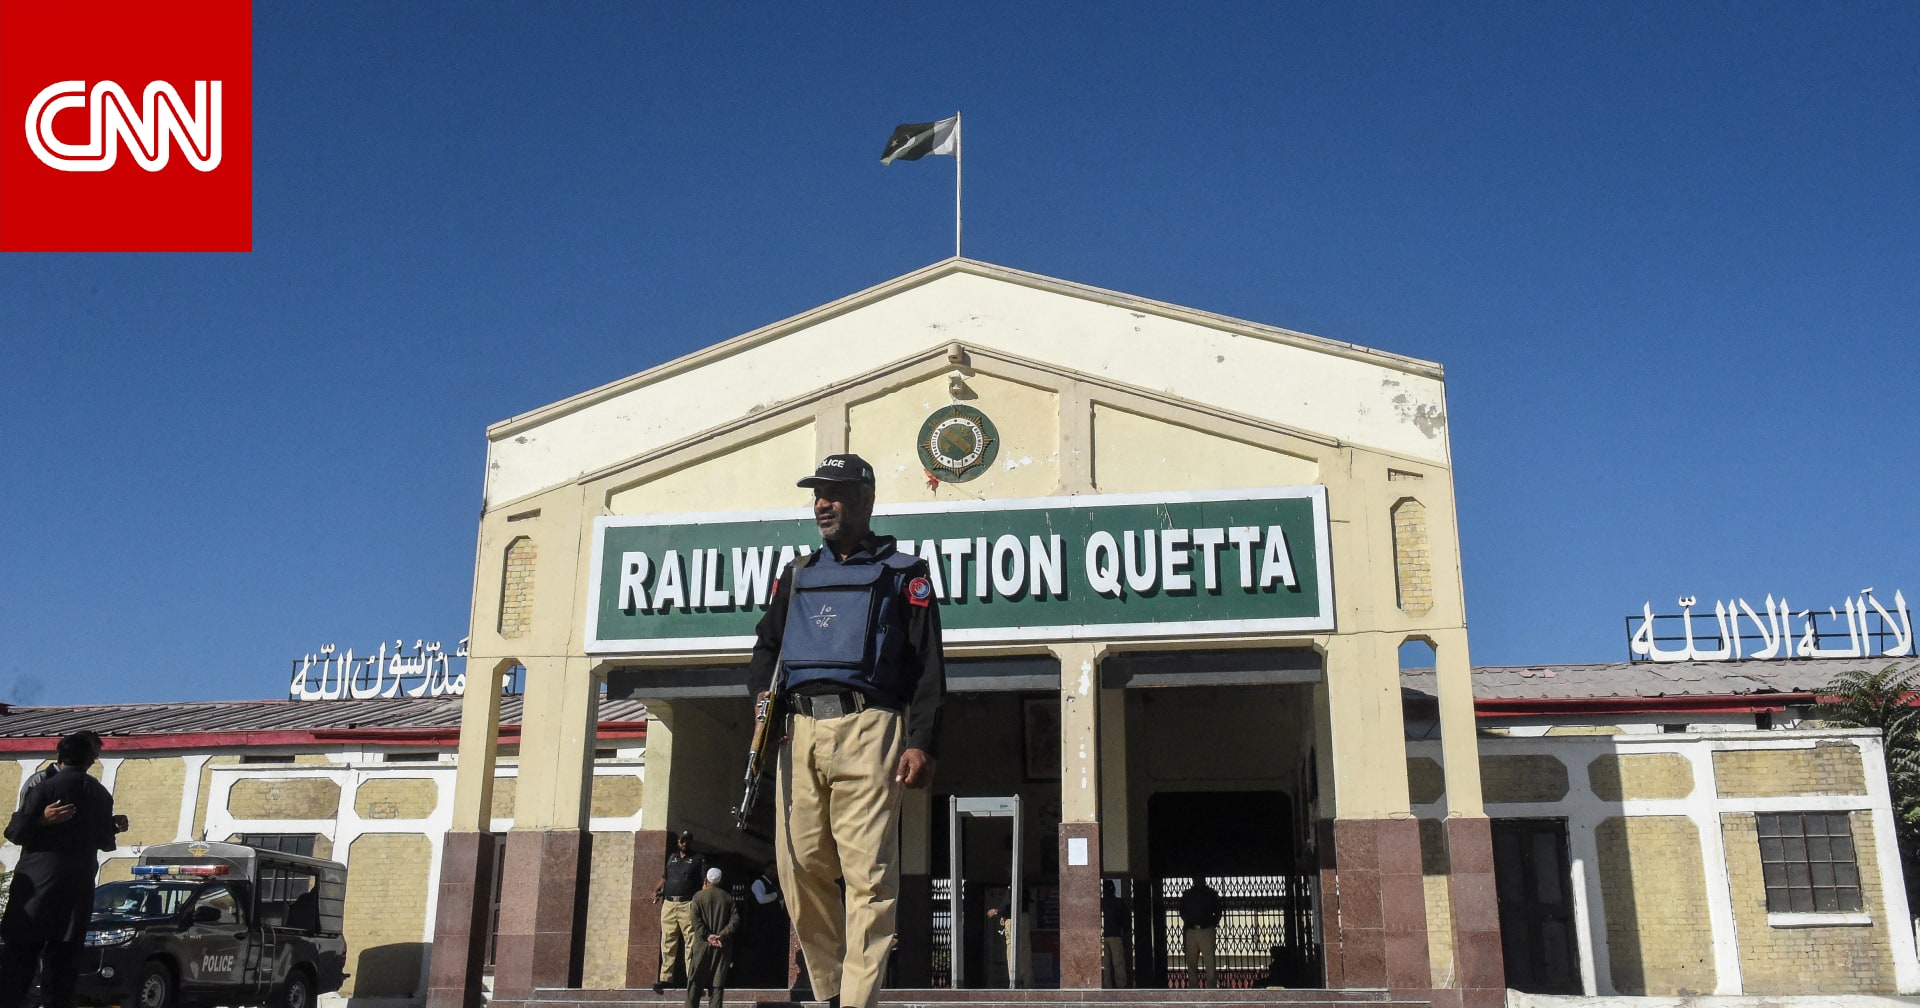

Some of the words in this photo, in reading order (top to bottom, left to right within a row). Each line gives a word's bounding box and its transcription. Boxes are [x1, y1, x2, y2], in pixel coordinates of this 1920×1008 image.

[619, 545, 823, 609] RAILWA
[897, 535, 1062, 599] ATION
[1086, 526, 1296, 597] QUETTA
[202, 955, 233, 972] POLICE
